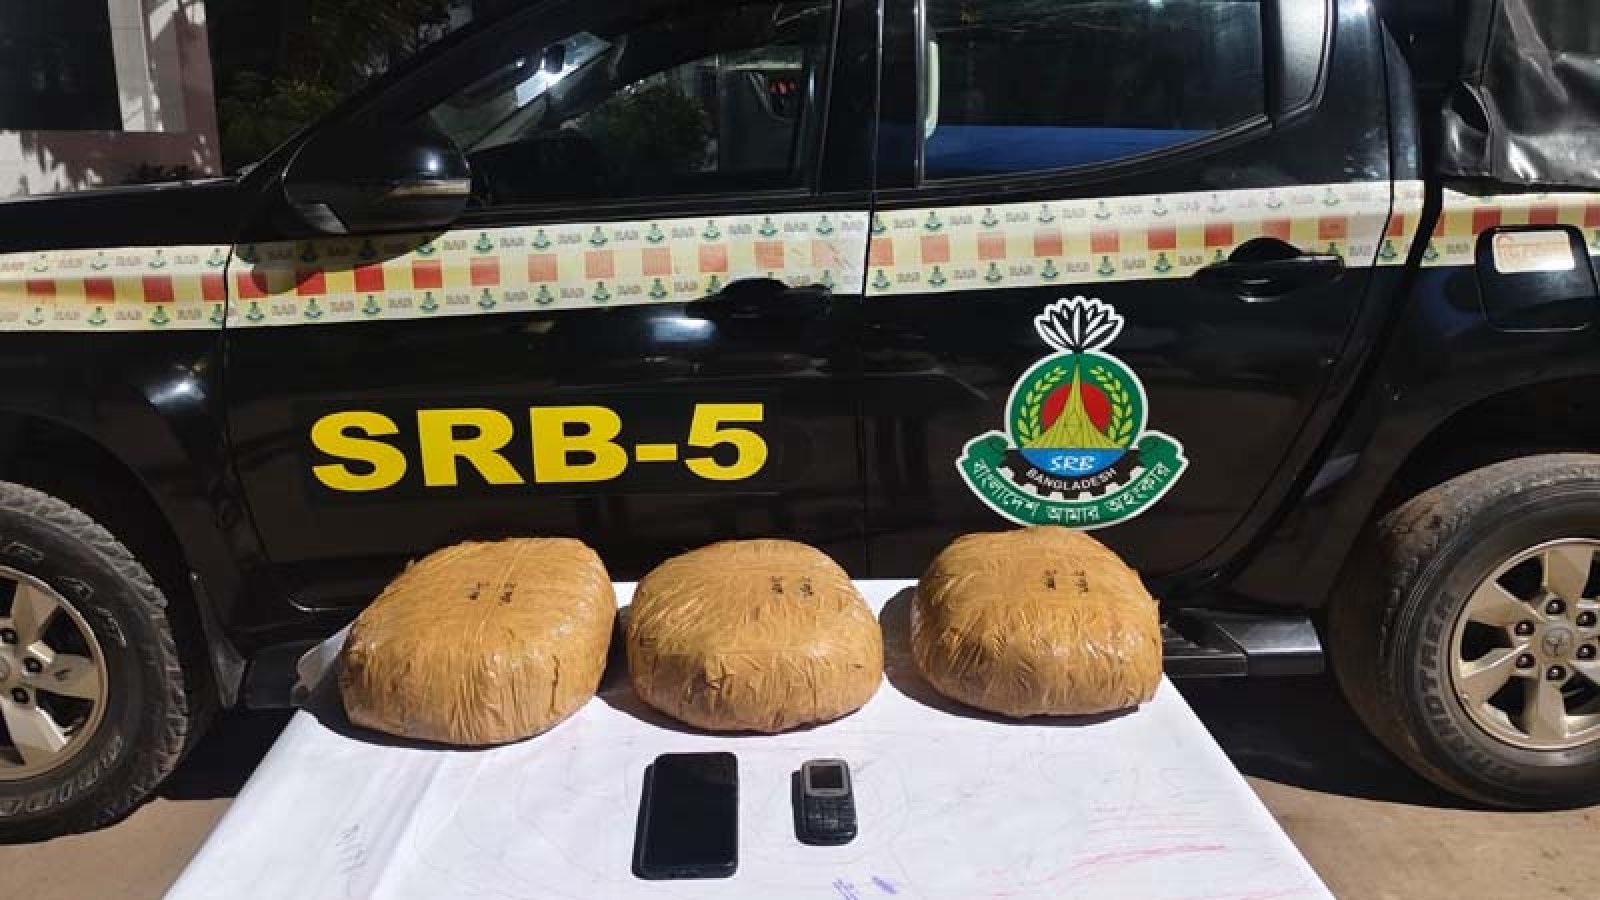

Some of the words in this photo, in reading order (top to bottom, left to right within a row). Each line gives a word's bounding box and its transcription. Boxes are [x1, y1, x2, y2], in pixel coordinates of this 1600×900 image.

[311, 403, 768, 491] SRB-5
[1050, 455, 1095, 470] SRB
[974, 458, 1040, 519] বাংলাদেশ
[1045, 504, 1100, 524] আমার
[1026, 468, 1117, 490] BANGLADESH
